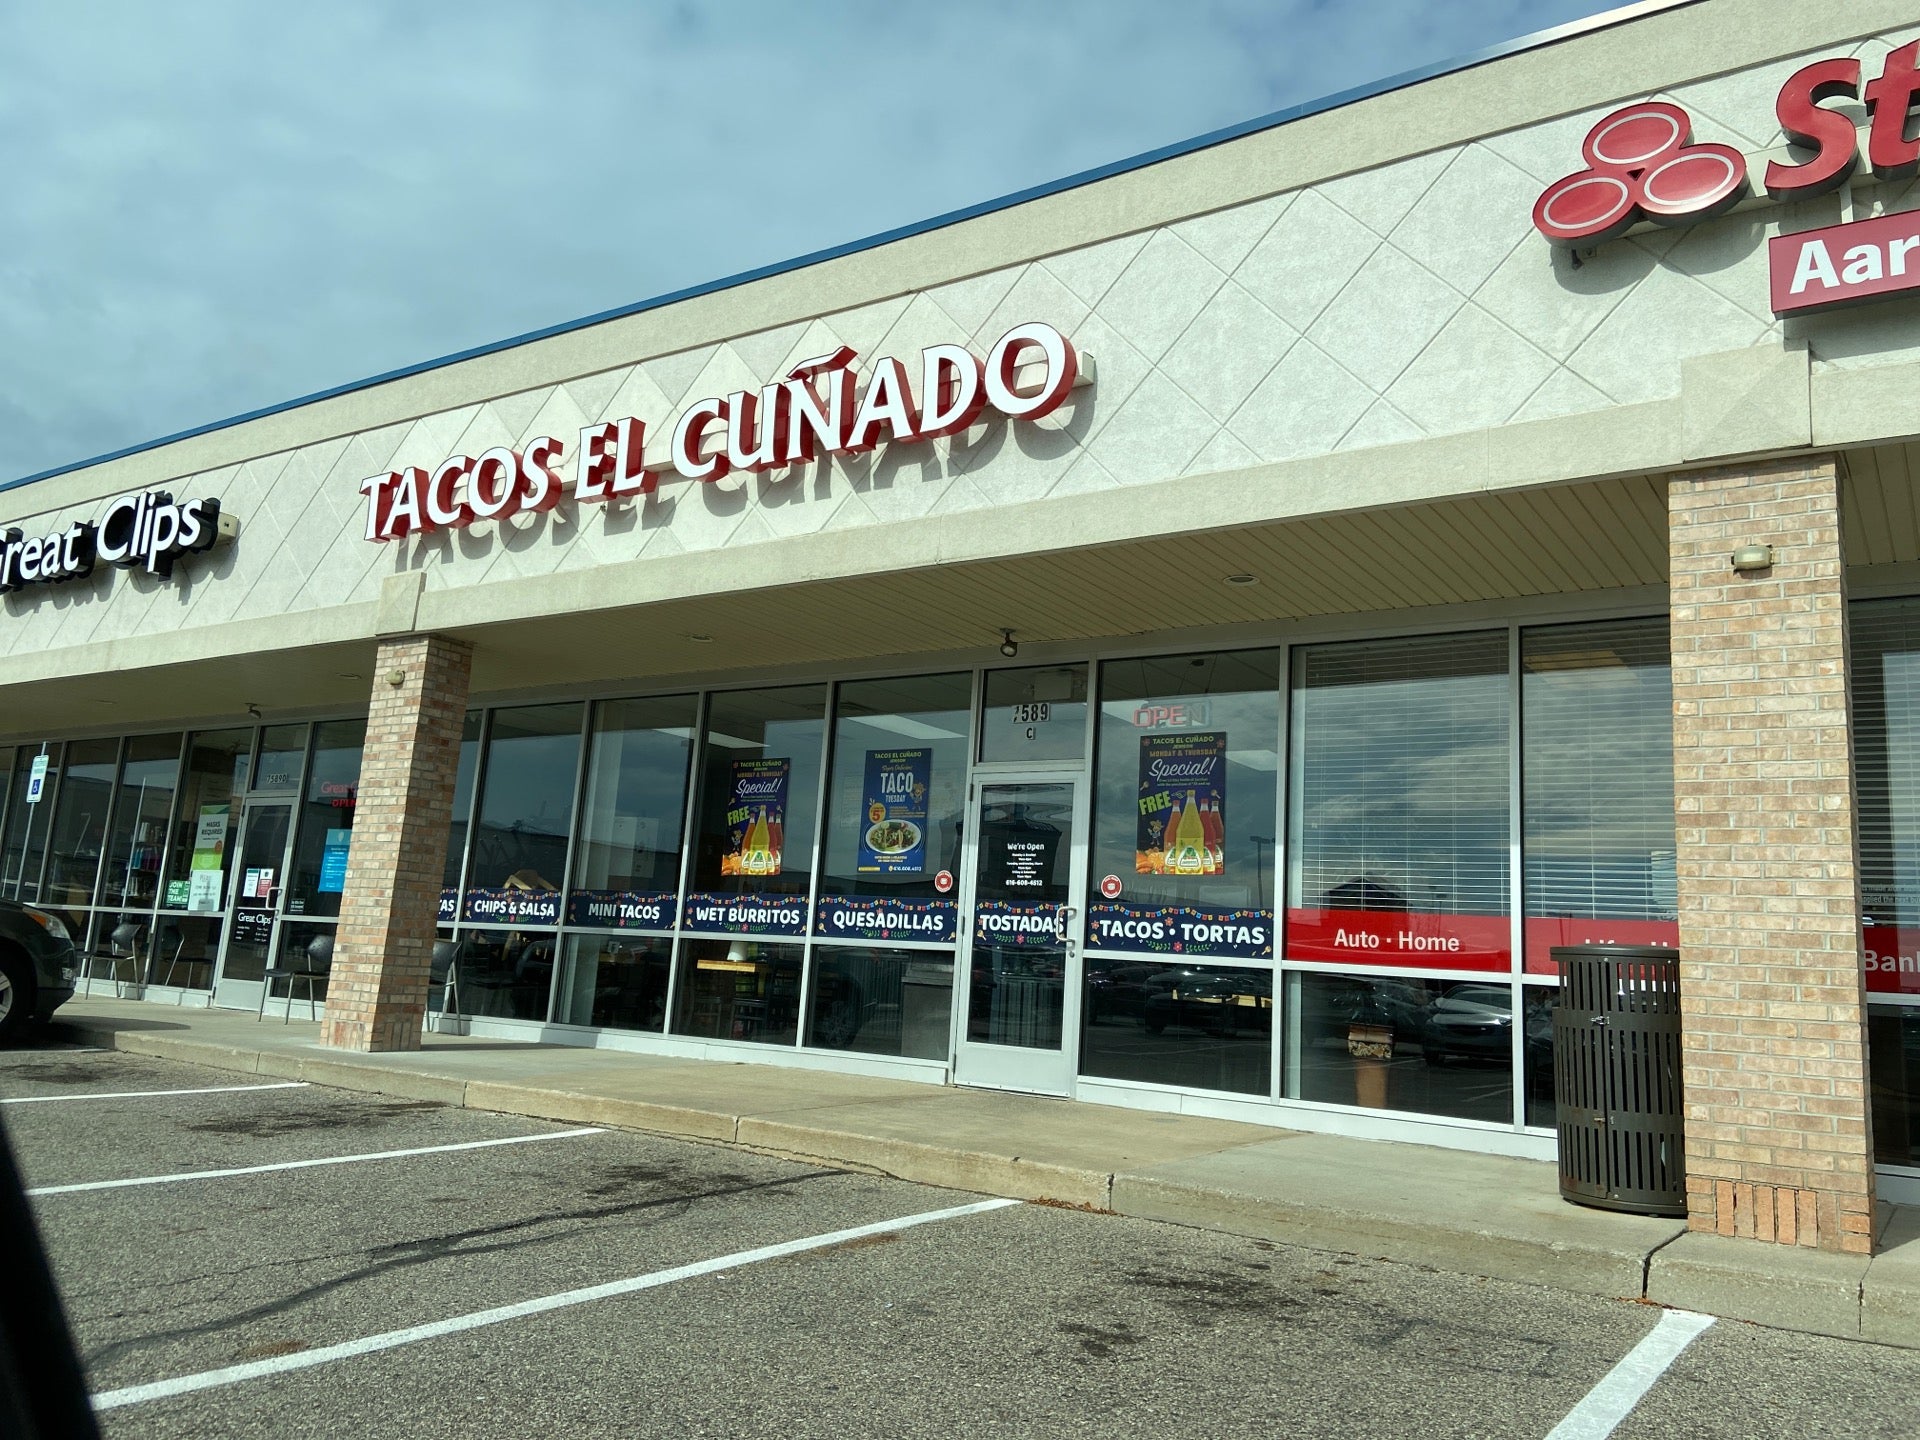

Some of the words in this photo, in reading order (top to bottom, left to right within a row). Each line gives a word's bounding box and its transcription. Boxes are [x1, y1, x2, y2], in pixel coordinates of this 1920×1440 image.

[360, 436, 560, 542] TACOS
[574, 417, 657, 503] EL
[671, 322, 1076, 482] CUÑADO
[97, 491, 208, 574] Clips
[1133, 703, 1208, 727] OPEN
[1149, 757, 1217, 781] Special!
[736, 778, 782, 798] Special!
[881, 772, 913, 794] TACO
[1139, 791, 1172, 815] FREE
[728, 806, 750, 826] FREE
[1026, 843, 1045, 851] Open
[439, 899, 455, 912] AS
[474, 899, 507, 914] CHIPS
[508, 901, 517, 914] &
[519, 902, 555, 917] SALSA
[588, 903, 616, 917] MINI
[620, 904, 660, 919] TACOS
[696, 906, 726, 922] WET
[728, 907, 800, 925] BURRITOS
[238, 912, 255, 923] Great
[256, 913, 271, 926] Clips
[833, 910, 944, 931] QUESADILLAS
[979, 913, 1064, 934] TOSTADAS
[1099, 919, 1164, 940] TACOS
[1180, 923, 1265, 945] TORTAS
[1333, 928, 1380, 949] Auto
[1398, 930, 1460, 952] Home
